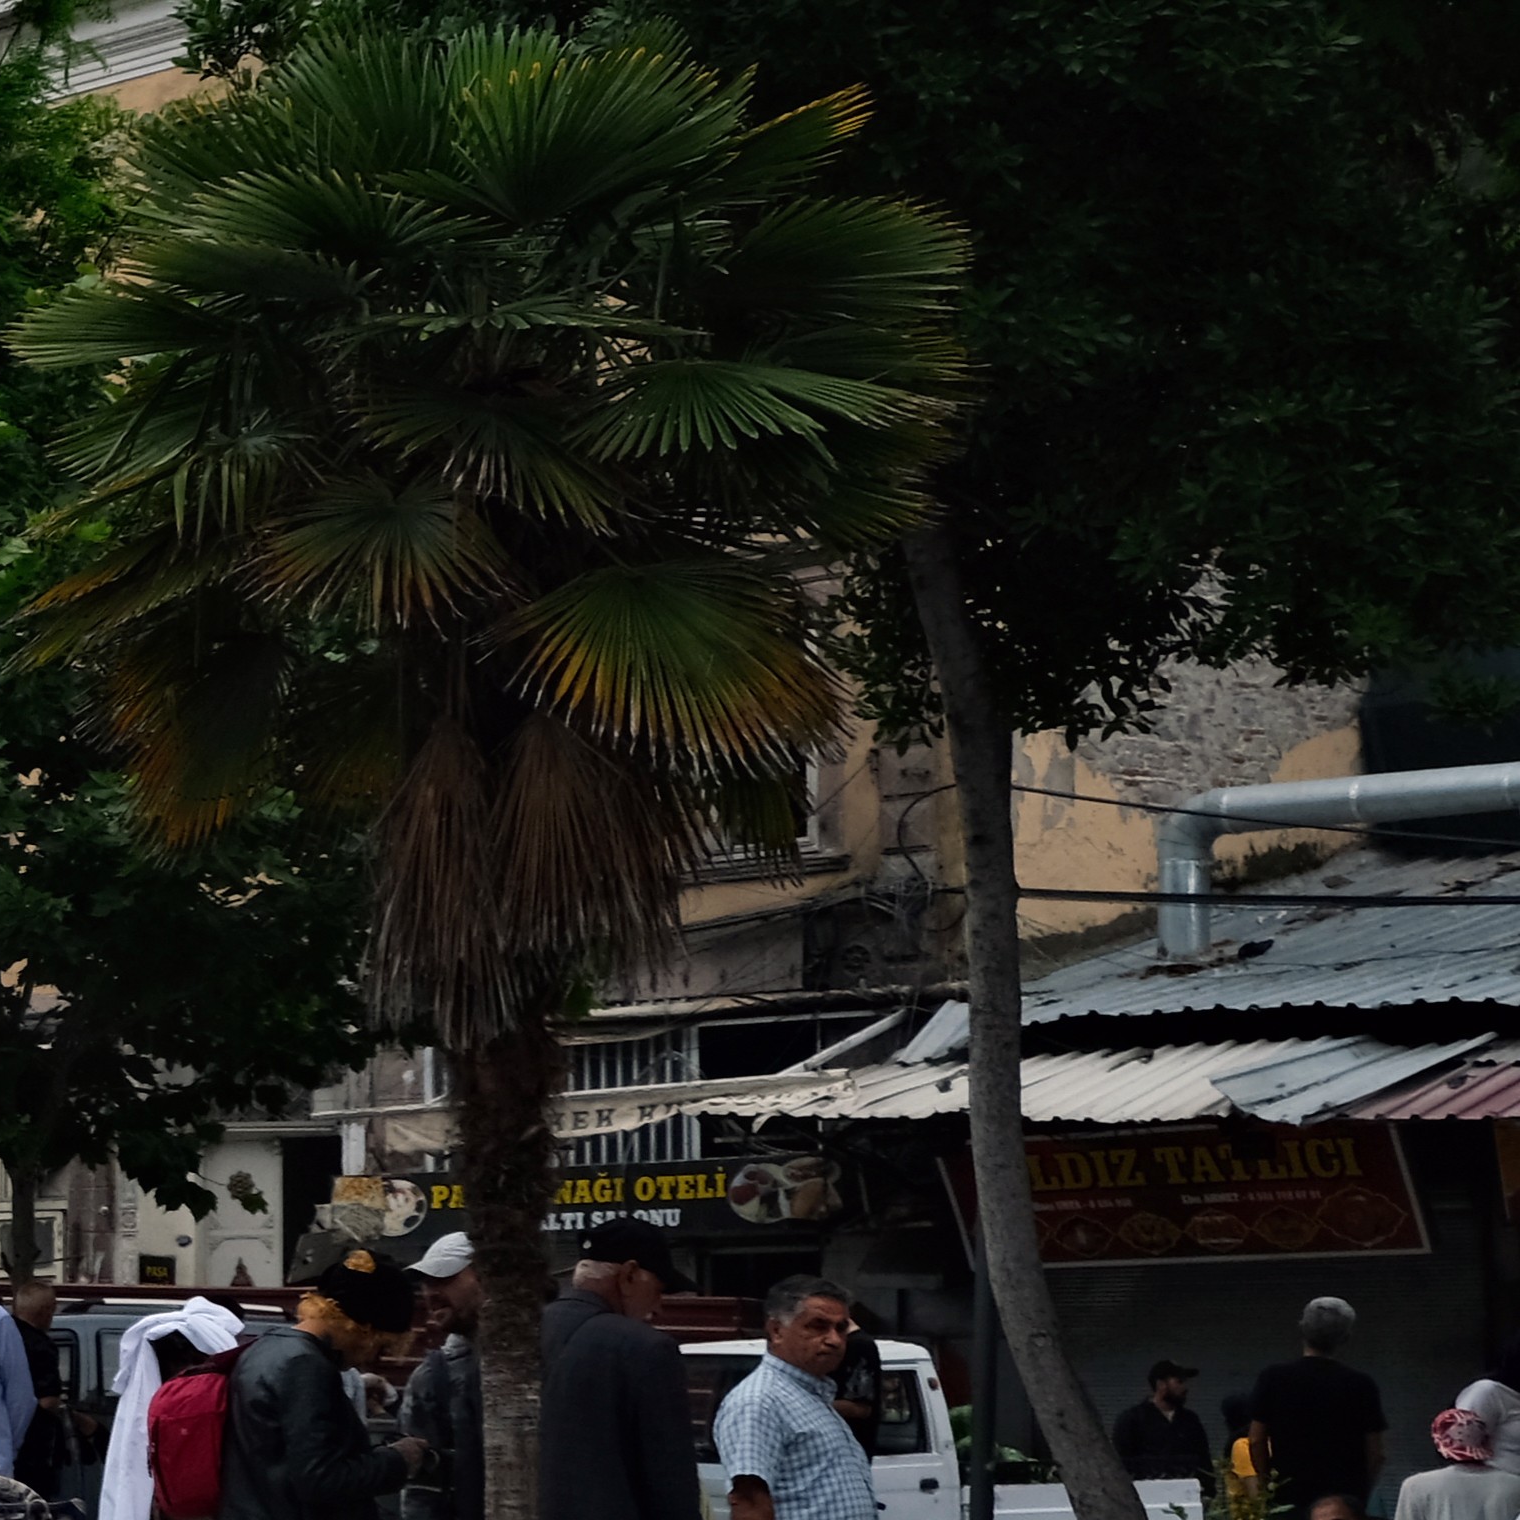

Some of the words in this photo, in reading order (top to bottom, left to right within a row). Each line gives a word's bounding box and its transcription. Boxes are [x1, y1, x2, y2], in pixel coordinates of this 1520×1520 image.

[553, 1172, 625, 1205] NAĞI
[634, 1166, 727, 1202] OTELİ
[1030, 1148, 1147, 1192] LDIZ
[590, 1208, 681, 1229] SAONU
